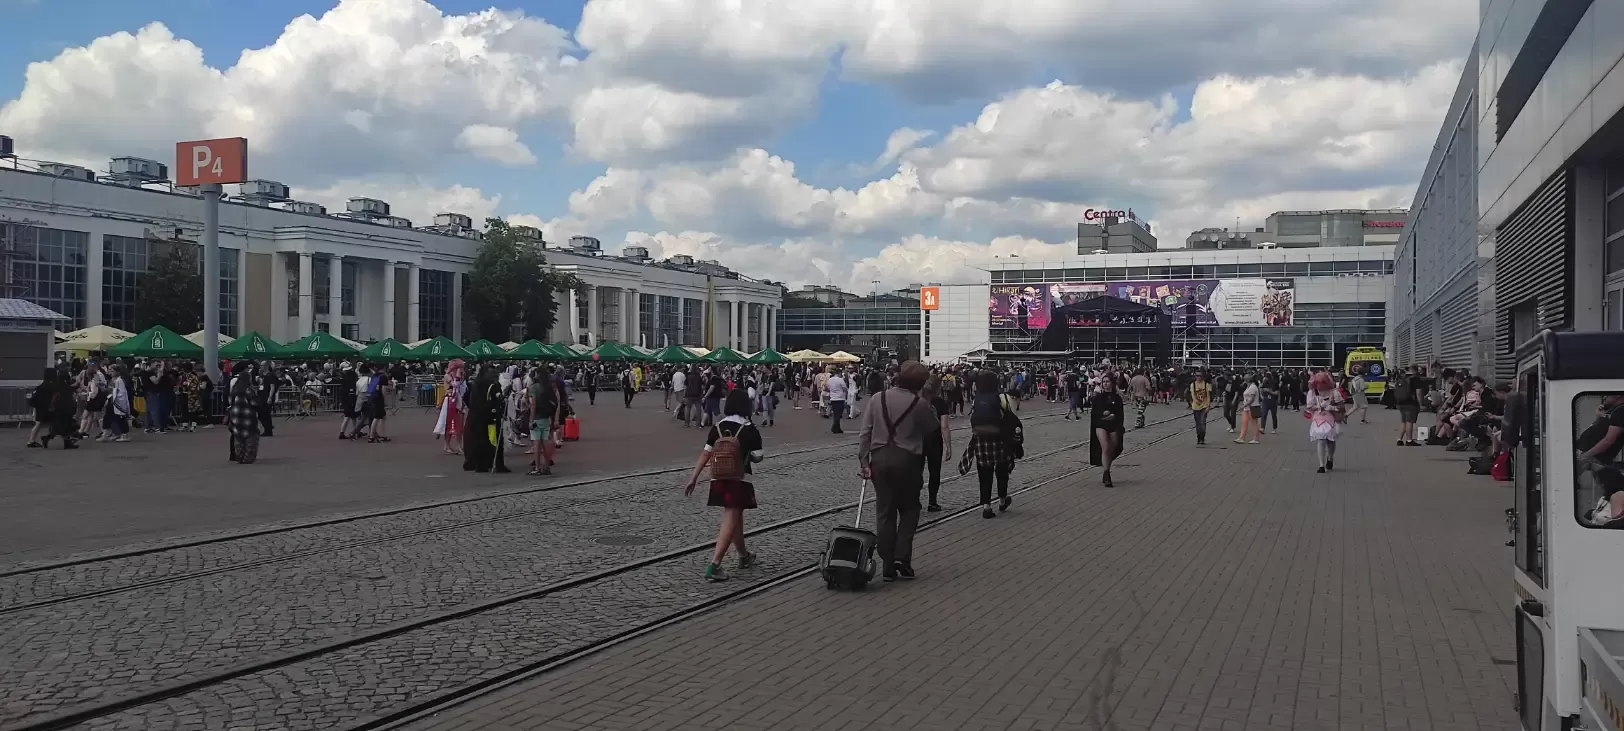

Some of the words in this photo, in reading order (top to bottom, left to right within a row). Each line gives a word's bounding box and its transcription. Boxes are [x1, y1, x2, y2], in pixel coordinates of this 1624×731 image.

[192, 145, 223, 179] P4
[1084, 207, 1132, 221] Central
[925, 291, 935, 305] 3A
